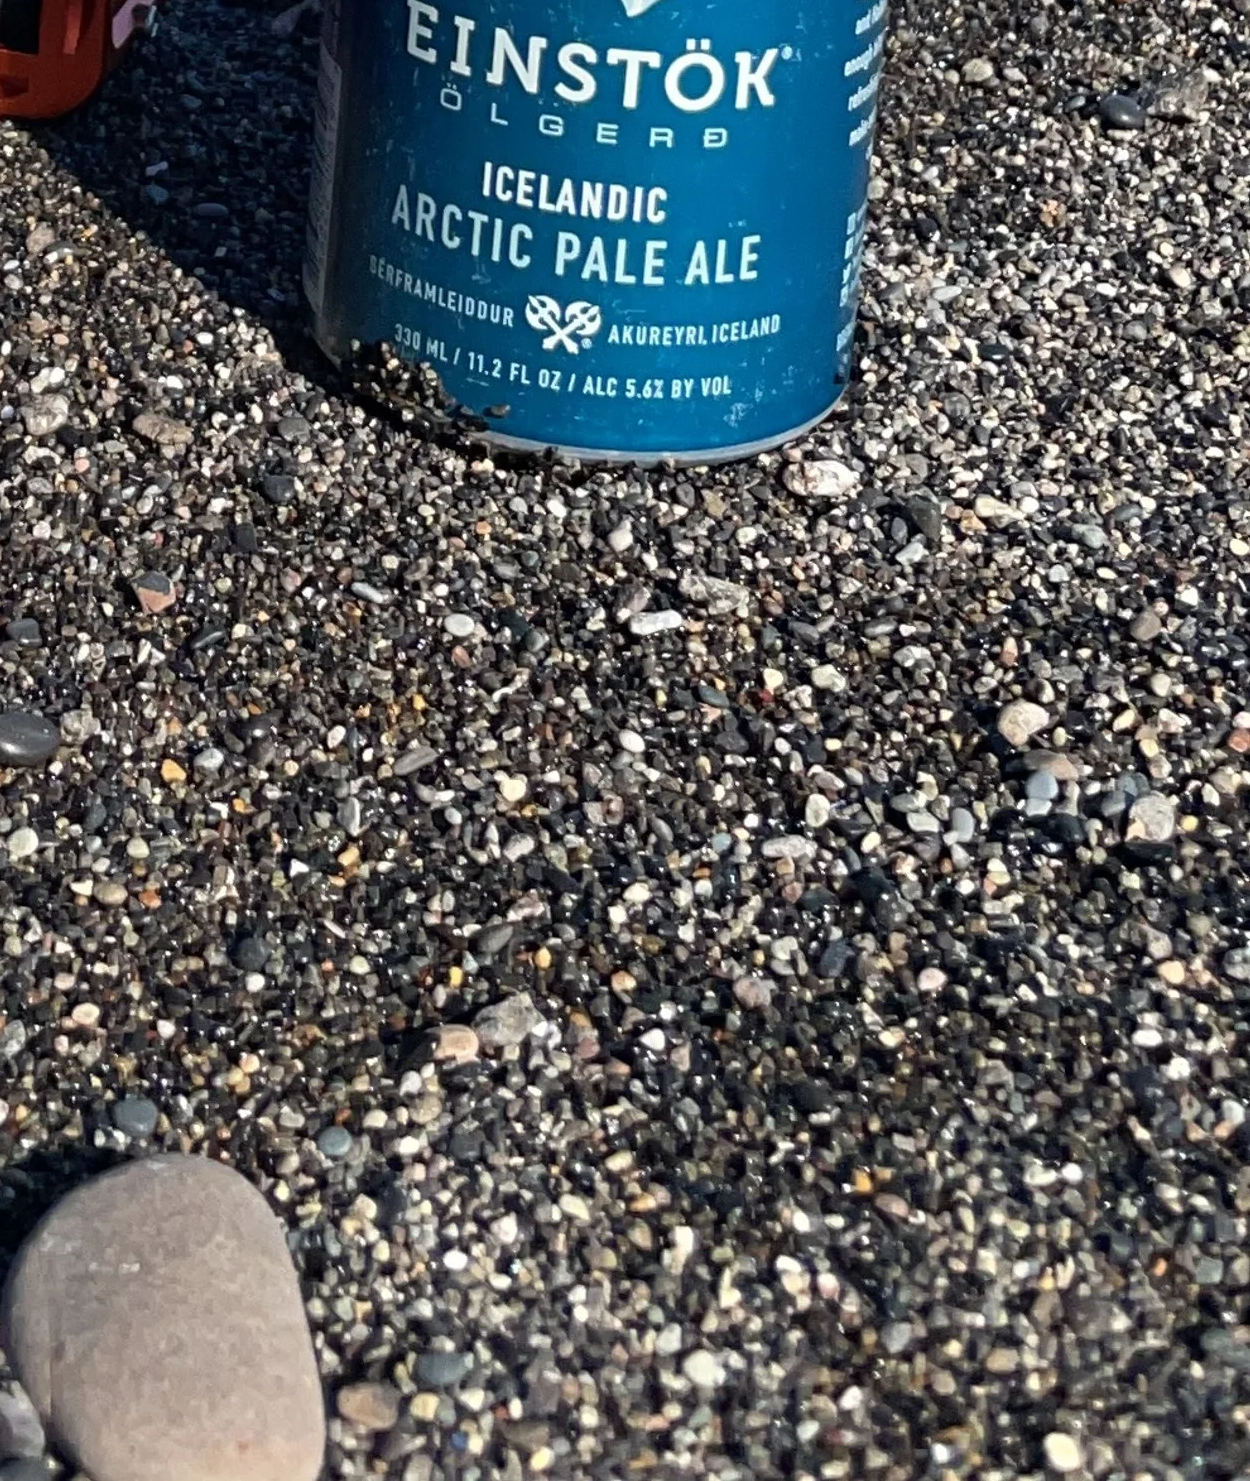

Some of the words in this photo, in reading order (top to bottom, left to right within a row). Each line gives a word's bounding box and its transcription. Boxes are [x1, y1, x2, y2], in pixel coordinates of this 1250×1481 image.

[482, 162, 668, 224] ICELANDIC
[391, 184, 534, 269] ARCTIC
[554, 231, 667, 286] PALE
[684, 234, 762, 285] ALE
[394, 323, 421, 351] 330
[426, 337, 448, 362] ML
[468, 351, 502, 378] 11.2
[510, 362, 531, 385] FL
[538, 369, 561, 391] OZ
[583, 375, 617, 398] ALC
[625, 379, 664, 399] 5.6%
[671, 378, 694, 399] BY
[701, 375, 731, 397] VOL
[712, 314, 780, 344] ICELAND
